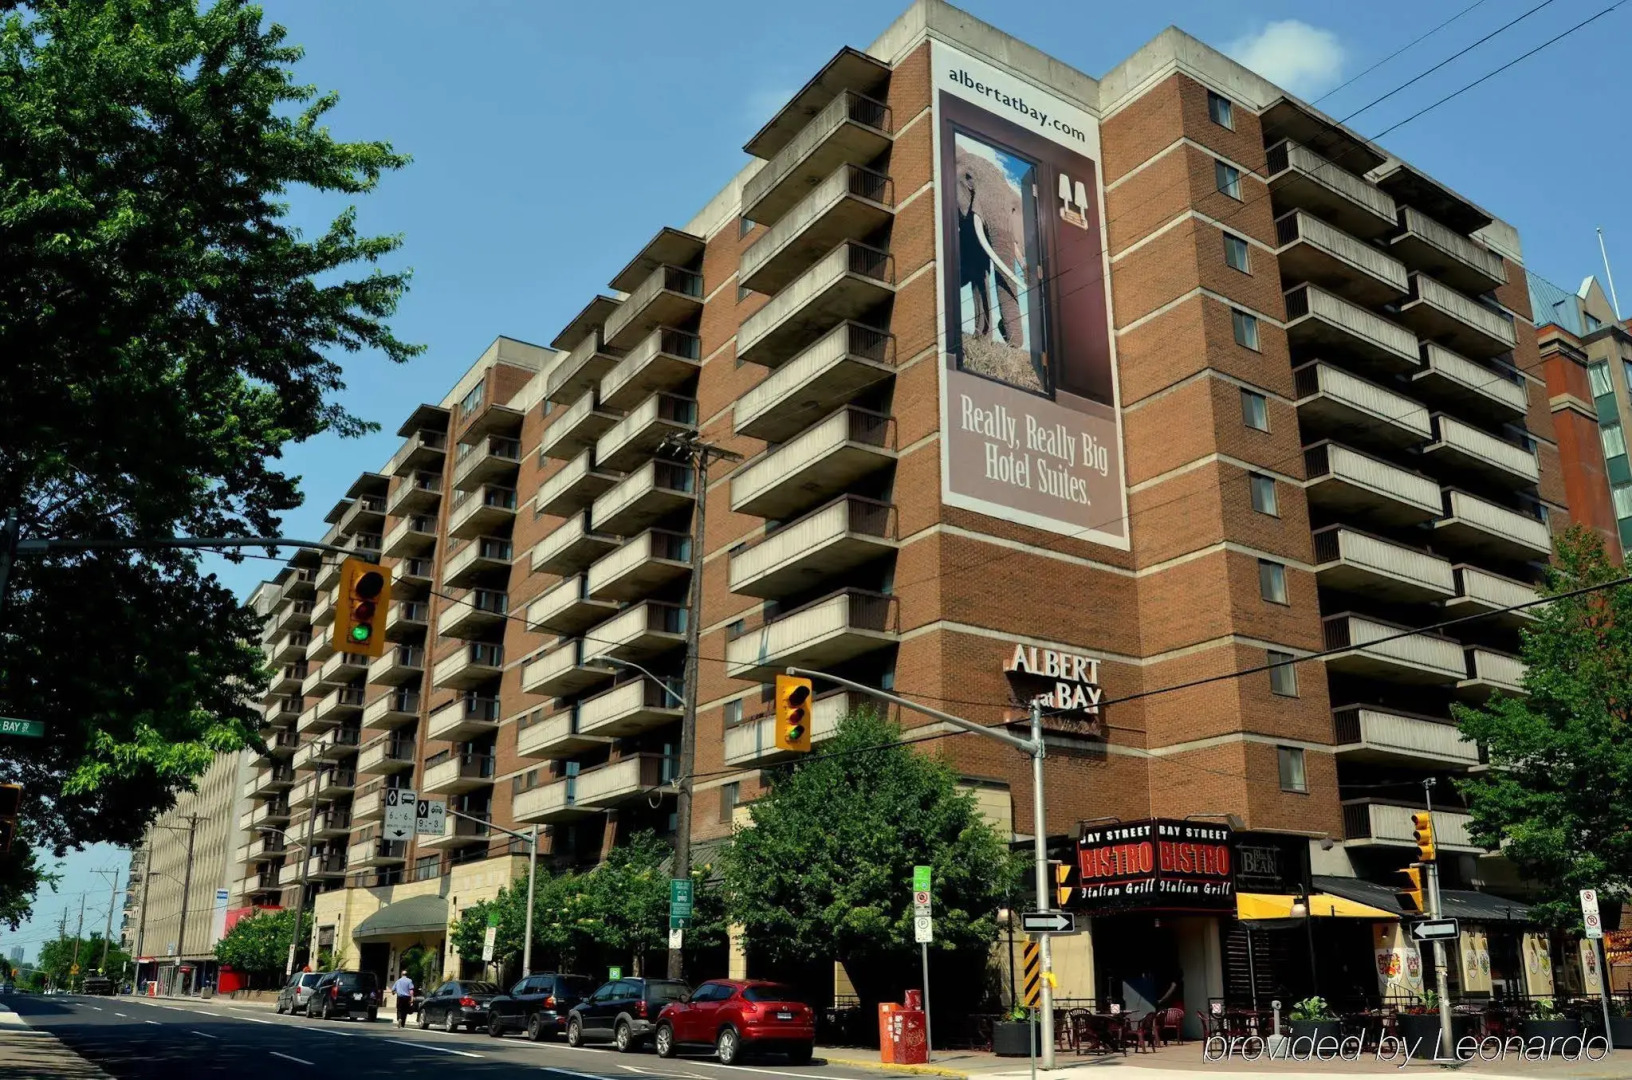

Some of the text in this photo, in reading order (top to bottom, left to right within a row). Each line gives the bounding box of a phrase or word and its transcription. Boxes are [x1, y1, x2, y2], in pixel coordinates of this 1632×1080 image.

[948, 68, 1086, 142] albertatbay.com
[960, 393, 1108, 477] Really, Really Big
[984, 442, 1092, 506] Hotel Suites.
[1010, 643, 1101, 685] ALBERT
[1038, 682, 1102, 714] at BAY
[3, 720, 21, 732] BAY
[1106, 825, 1151, 841] STREET
[1158, 825, 1228, 840] BAY STREET
[1079, 841, 1154, 879] BISTRO
[1159, 841, 1230, 876] BISTRO
[1242, 852, 1275, 874] BEAR
[1081, 878, 1156, 899] Italian Grill
[1160, 879, 1199, 894] Italian
[1203, 882, 1231, 895] Grill
